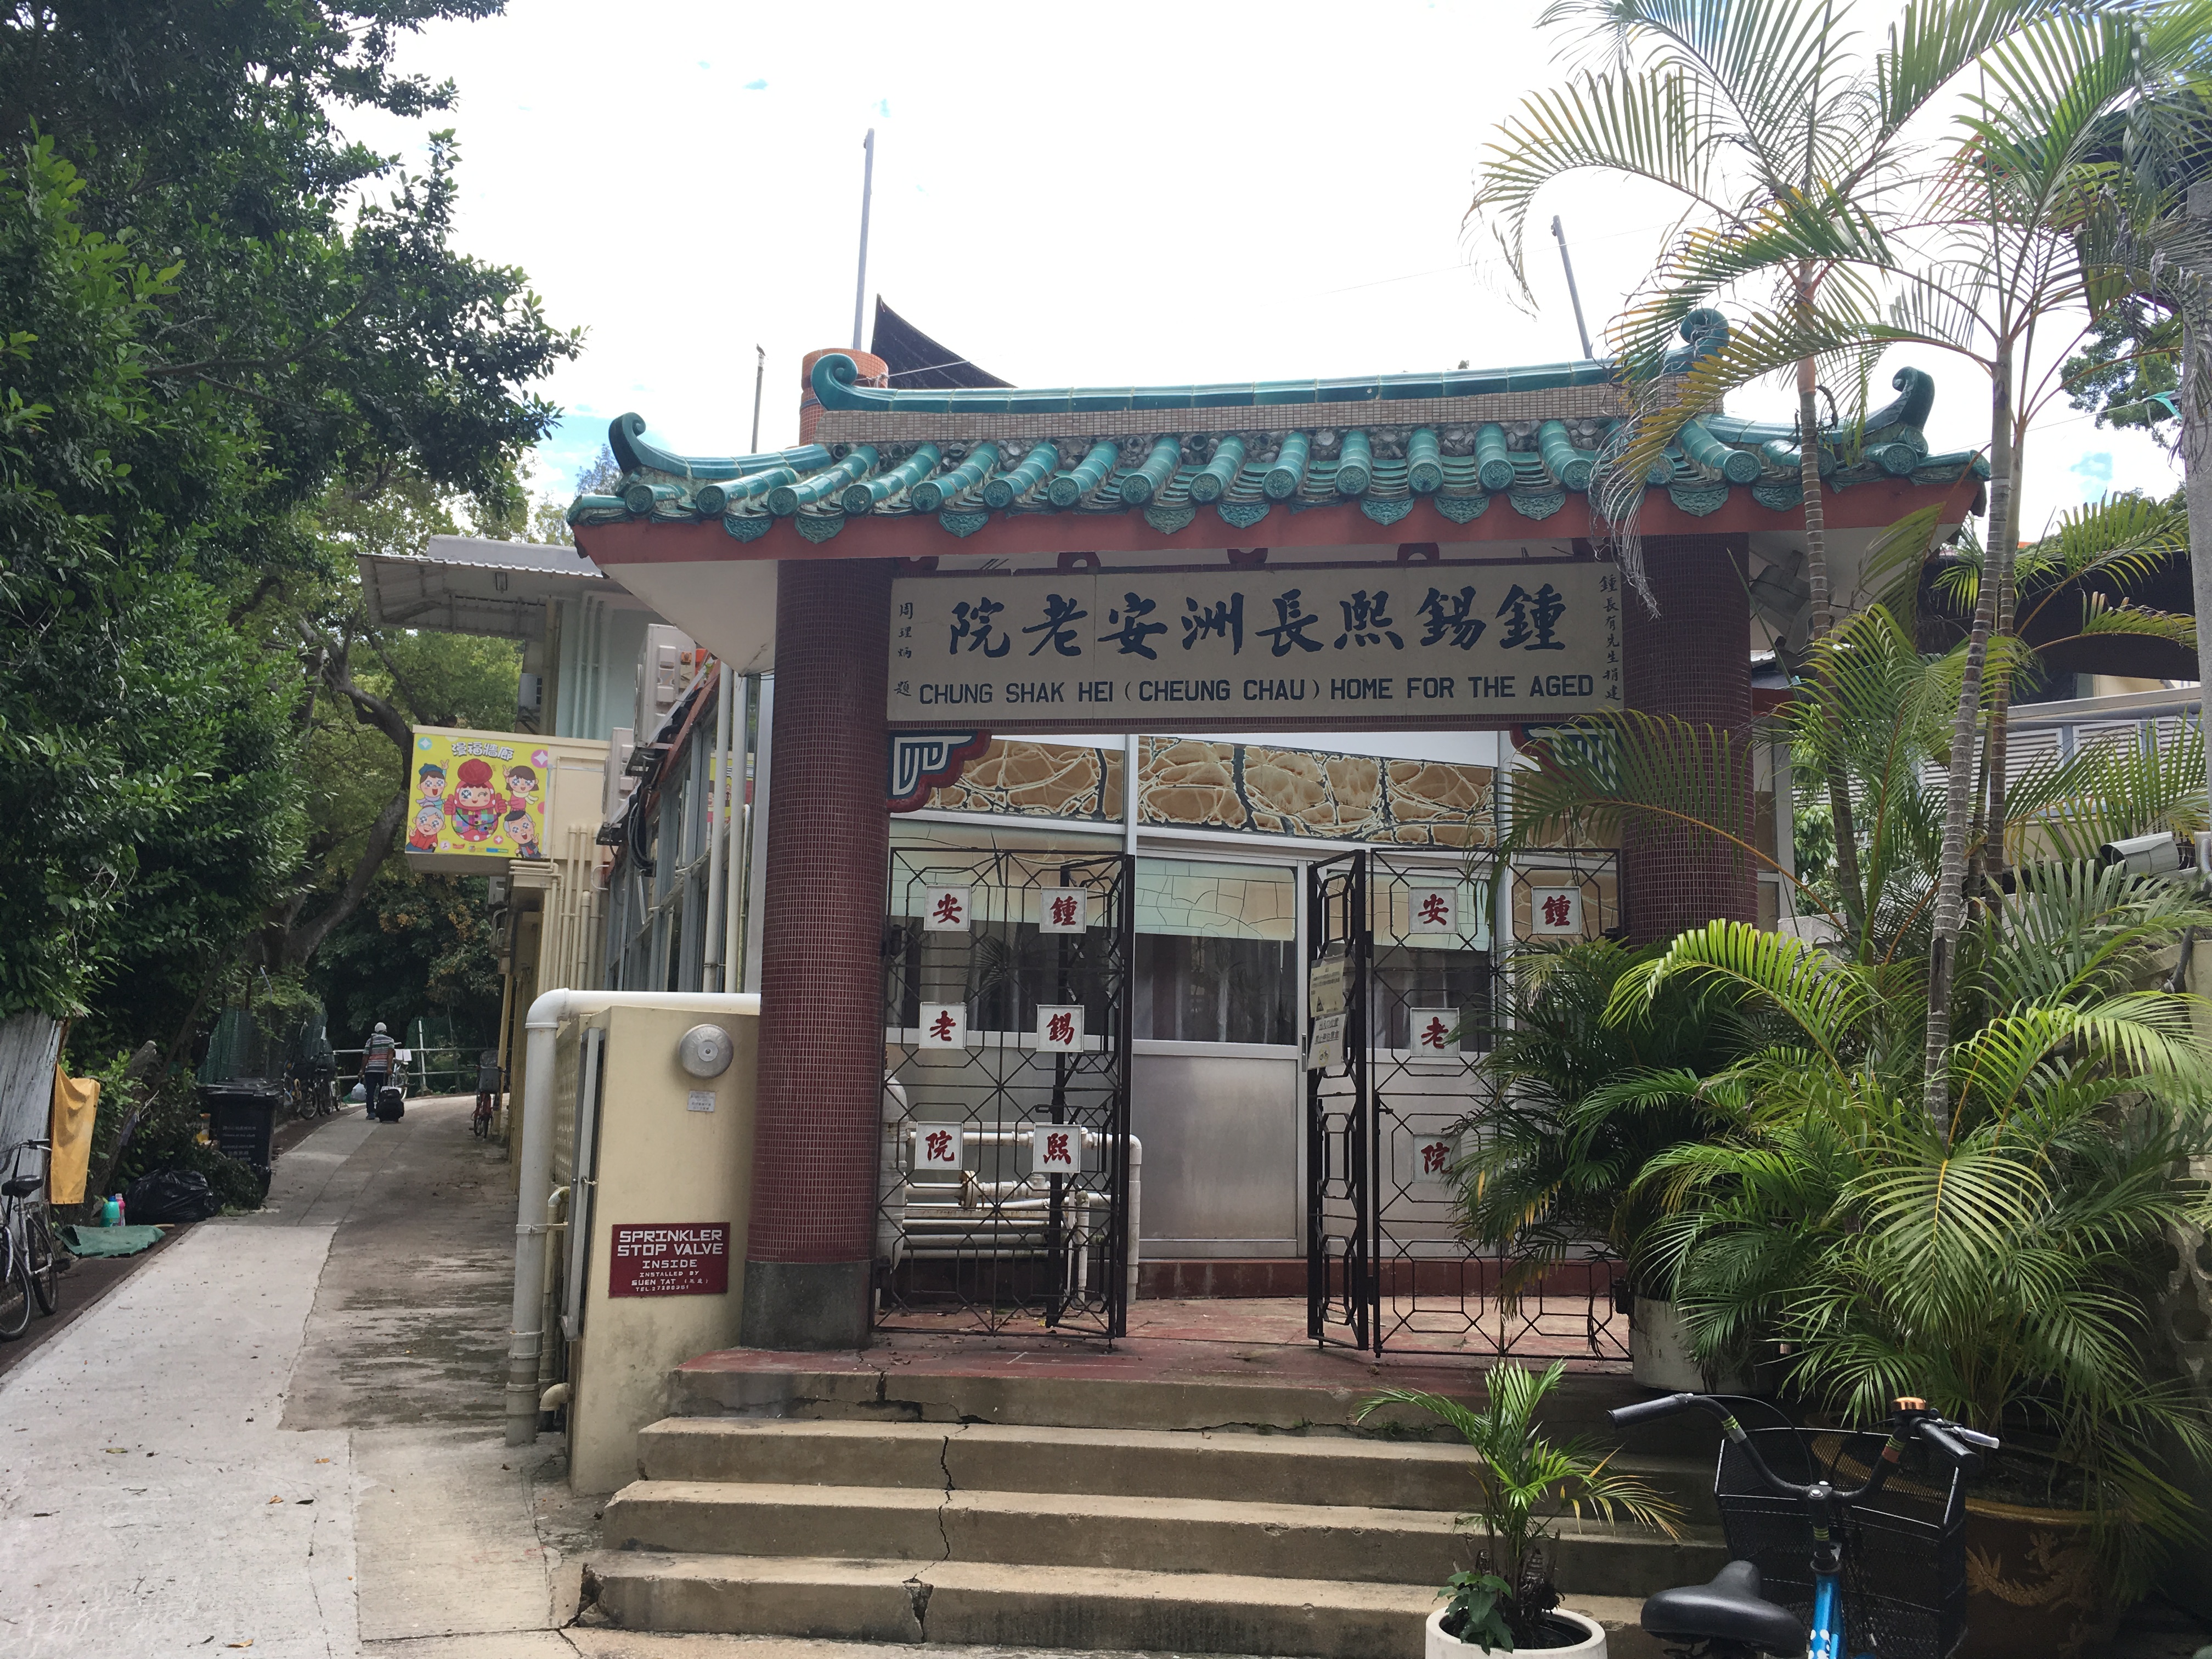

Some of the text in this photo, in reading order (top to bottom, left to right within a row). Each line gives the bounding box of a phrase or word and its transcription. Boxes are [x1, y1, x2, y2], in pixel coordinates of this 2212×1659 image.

[920, 675, 1593, 704] CHUNG SHAK HEI (CHEUNG CHAU) HOME FOR THE AGED
[926, 894, 962, 1161] 安 老 院
[1048, 1013, 1074, 1044] 錫
[1418, 894, 1453, 1174] 安 老 院
[1044, 1133, 1071, 1164] 熙
[618, 1243, 723, 1256] STOP VALVE
[619, 1230, 721, 1242] SPRINKLER
[642, 1260, 697, 1268] INSIDE
